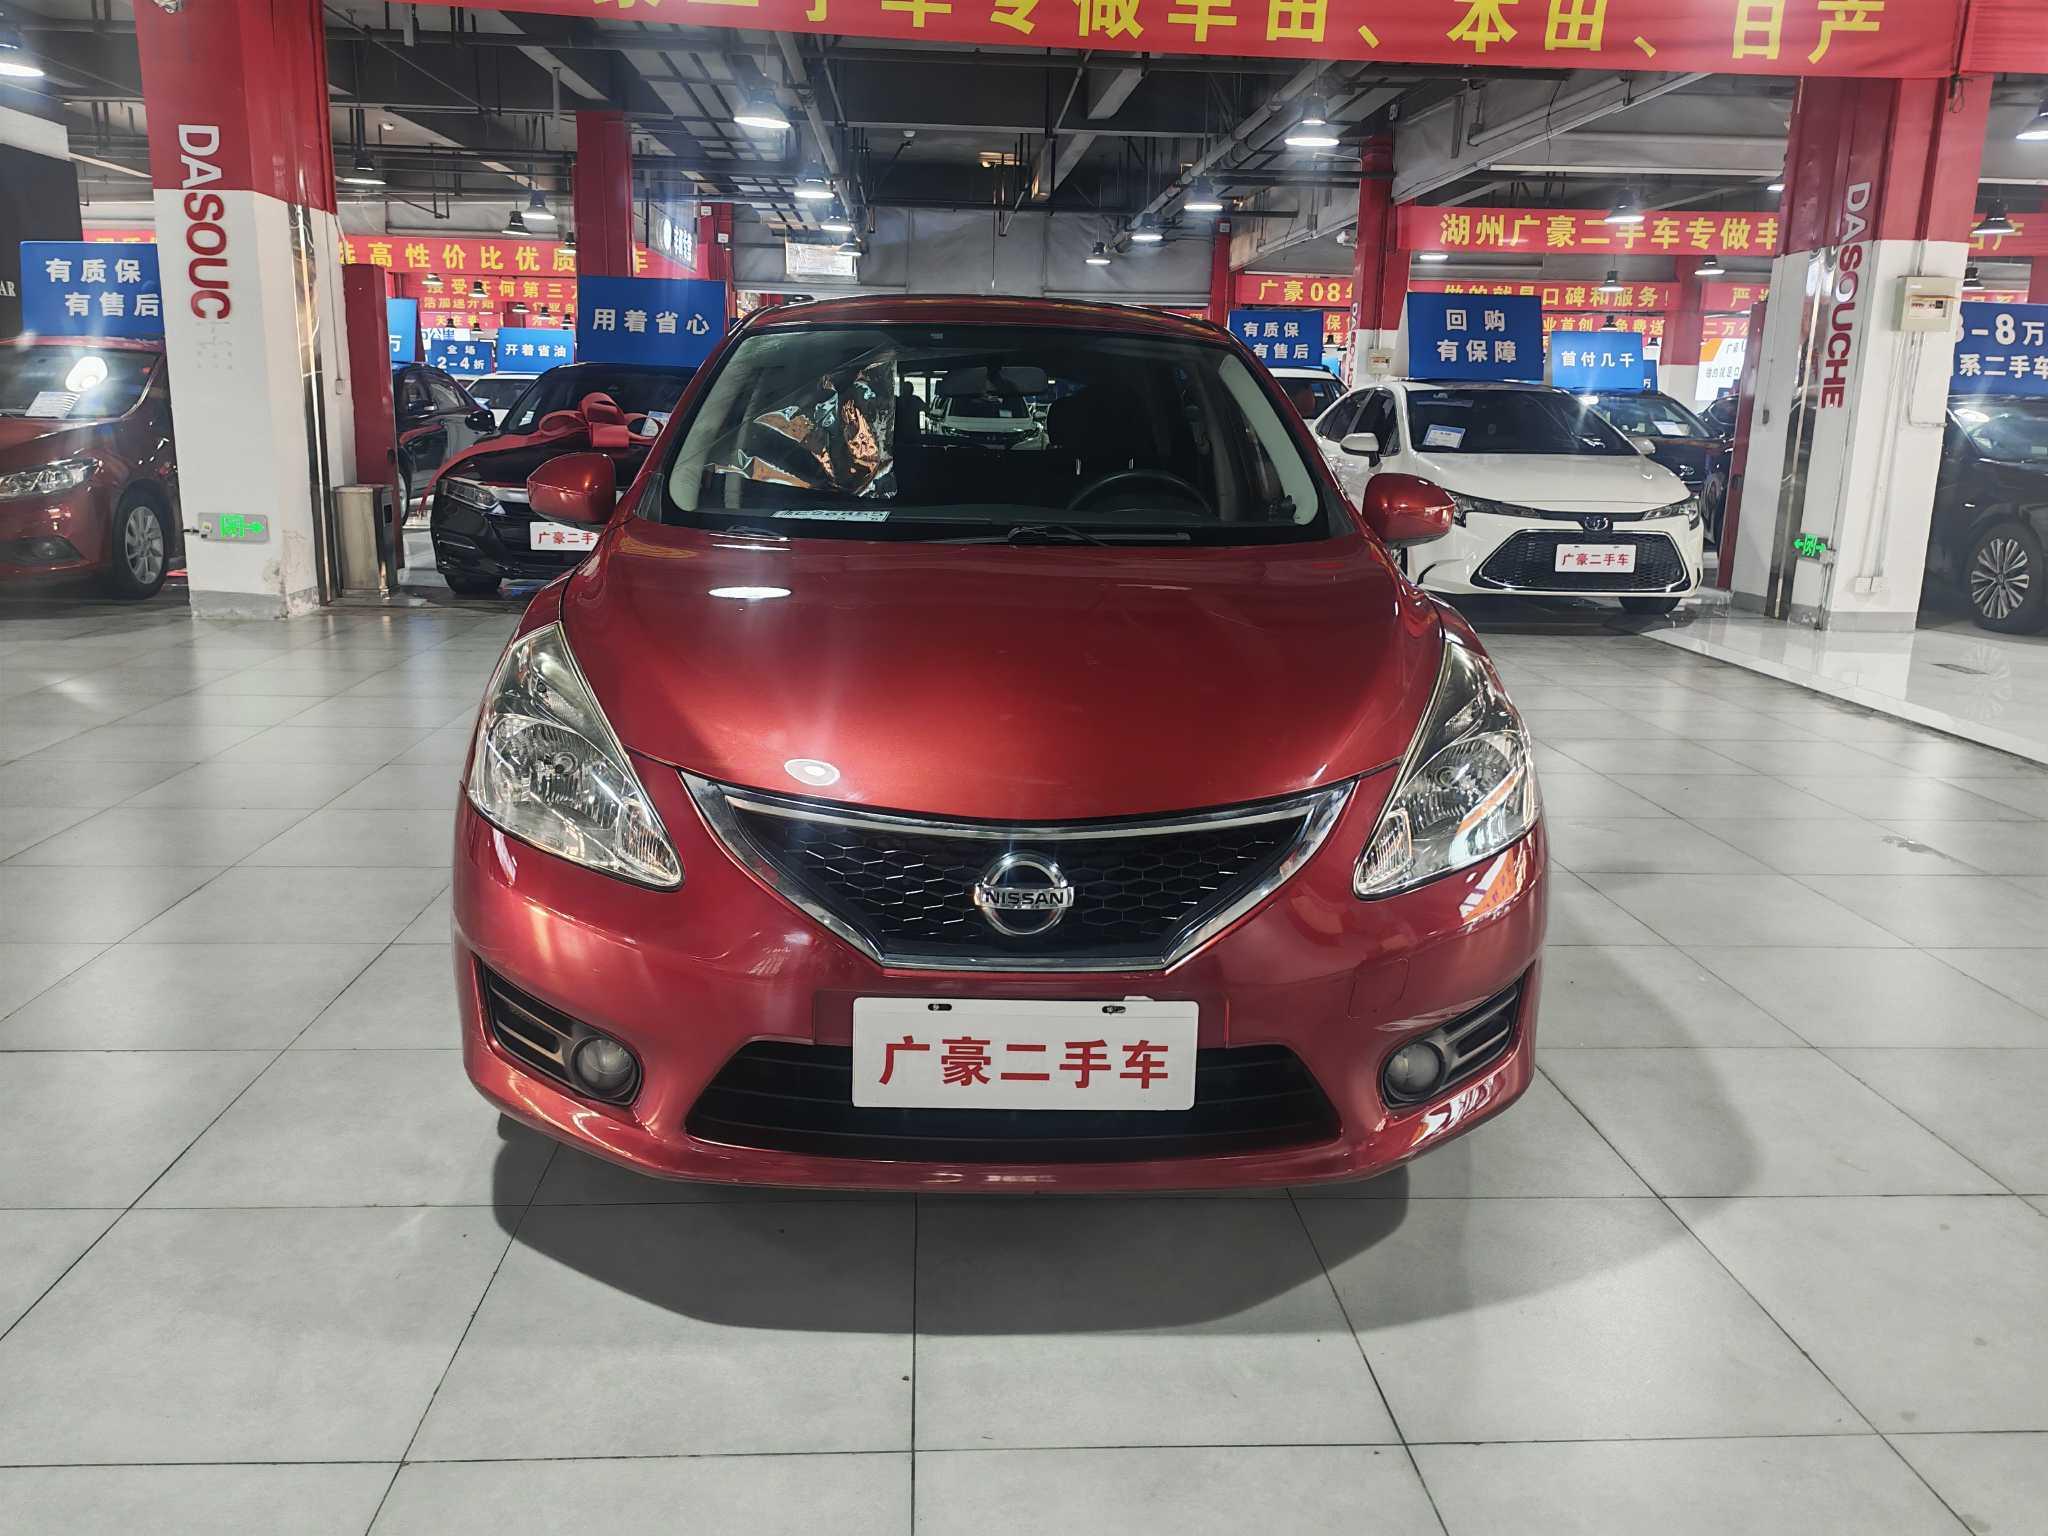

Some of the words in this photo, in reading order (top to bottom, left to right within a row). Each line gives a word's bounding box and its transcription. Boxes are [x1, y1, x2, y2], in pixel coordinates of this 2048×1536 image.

[46, 258, 141, 284] 有质保
[65, 291, 160, 317] 有售后
[1820, 181, 1873, 409] DASOUCHE
[592, 308, 711, 336] 用着省心
[1243, 321, 1299, 338] 有质保
[1445, 309, 1505, 332] 回购
[505, 343, 567, 357] 开着省油
[1253, 342, 1310, 360] 有售后
[1437, 338, 1517, 363] 有保障
[1561, 351, 1635, 368] 首付几千
[1562, 552, 1630, 567] 广豪二手车
[984, 892, 1065, 905] NISSAN
[879, 1035, 1169, 1089] 广豪二手车
